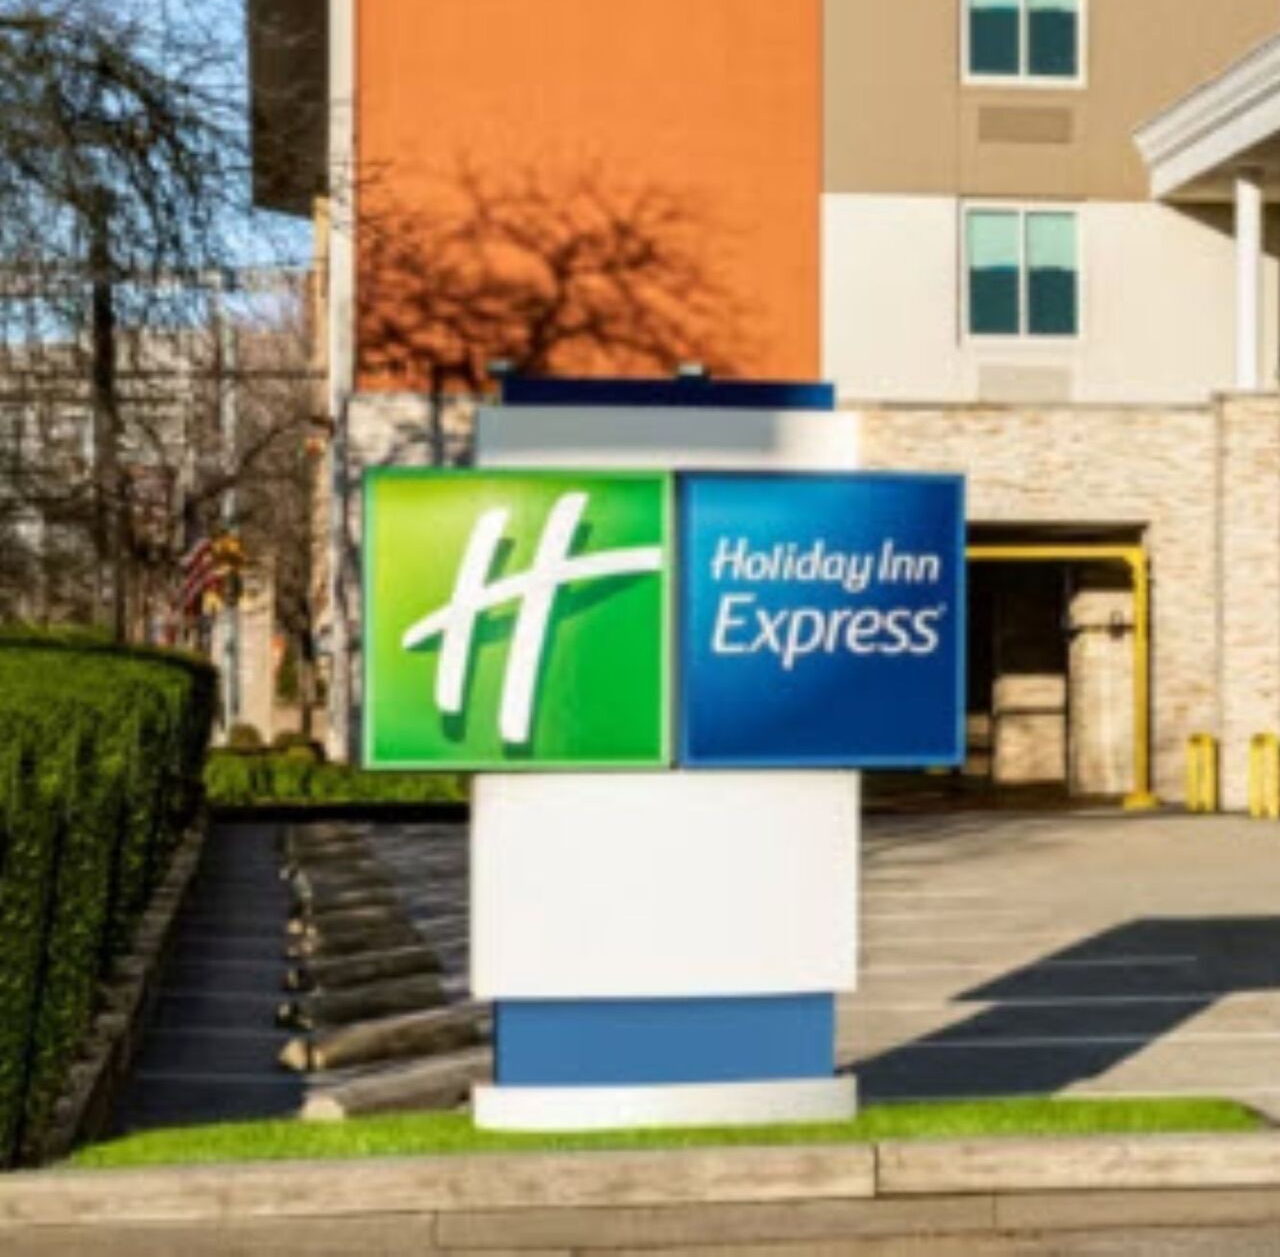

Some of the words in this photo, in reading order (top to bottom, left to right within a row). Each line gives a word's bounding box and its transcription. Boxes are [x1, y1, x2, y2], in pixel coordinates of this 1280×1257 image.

[710, 536, 873, 592] Holiday
[877, 537, 941, 583] Inn
[711, 592, 942, 670] Express
